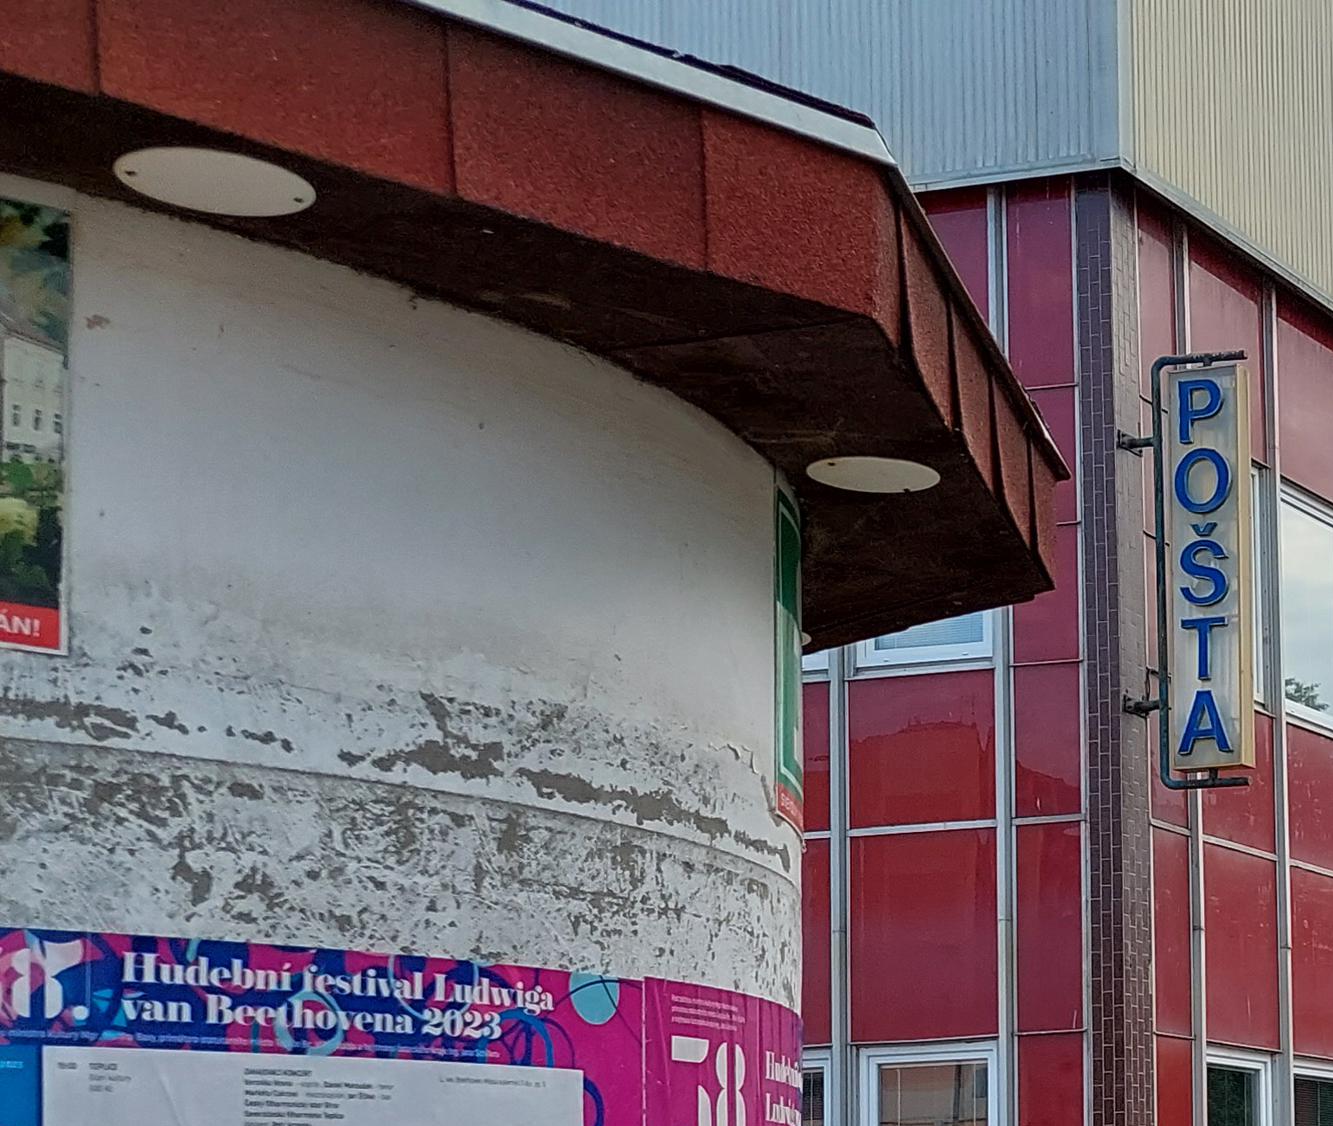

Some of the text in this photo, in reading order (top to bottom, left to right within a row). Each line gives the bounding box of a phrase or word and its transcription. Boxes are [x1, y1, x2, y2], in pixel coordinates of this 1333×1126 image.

[1174, 378, 1233, 754] POŠTA
[0, 938, 90, 1021] 8.
[122, 951, 554, 1015] Hudební festival Ludwiga
[121, 994, 502, 1040] van Beethovena 2023
